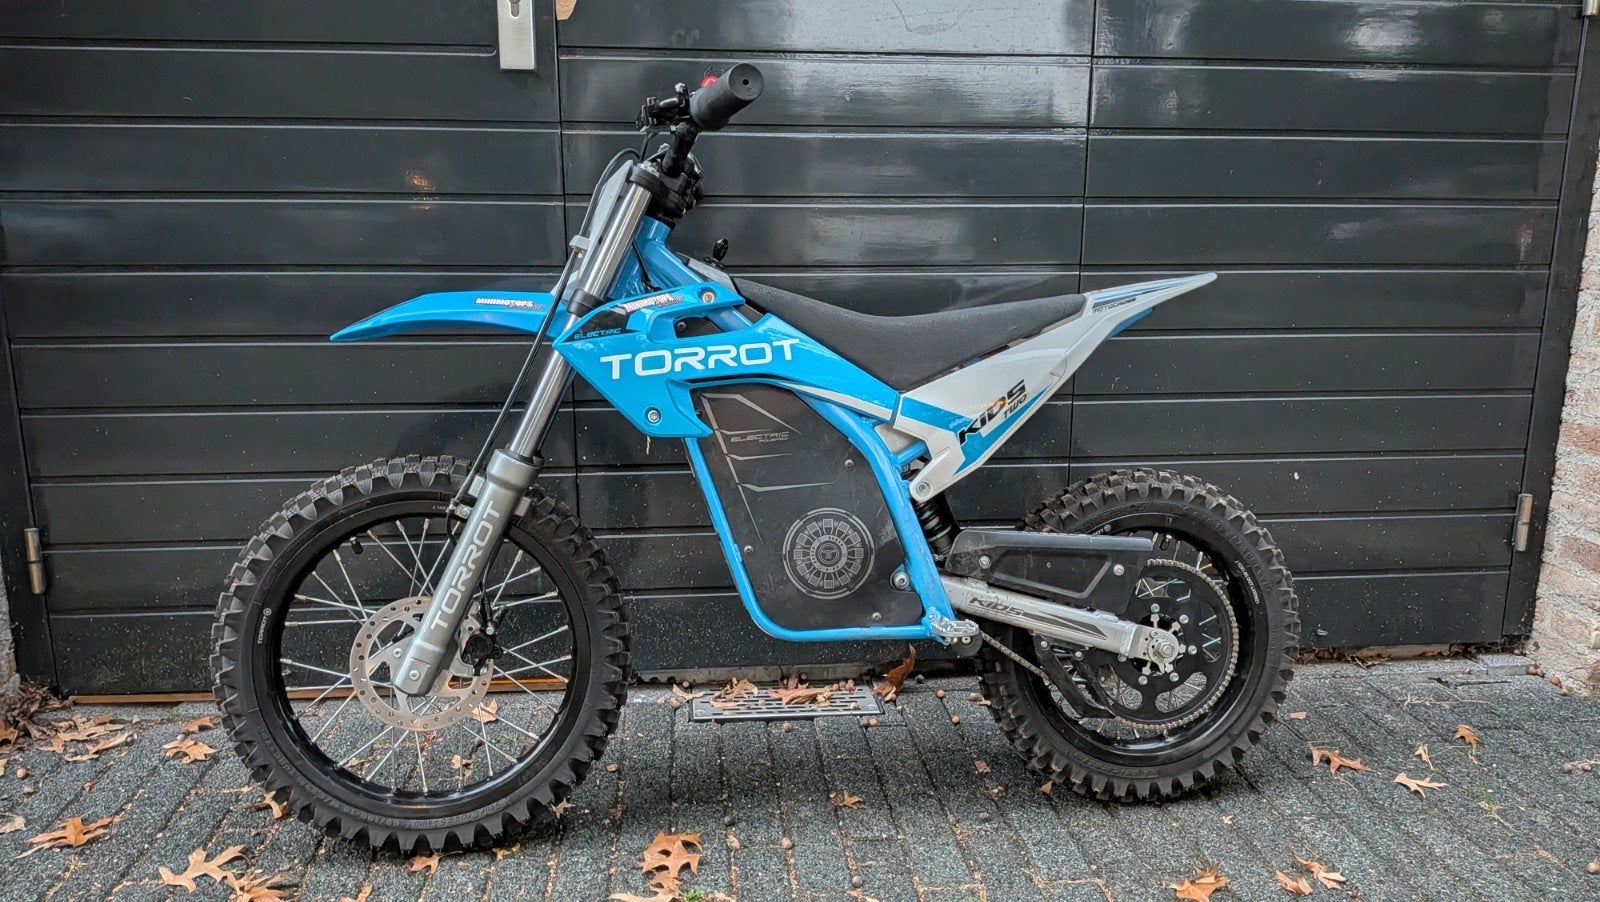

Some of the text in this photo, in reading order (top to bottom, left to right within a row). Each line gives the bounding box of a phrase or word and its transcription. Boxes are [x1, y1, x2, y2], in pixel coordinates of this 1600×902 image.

[573, 327, 622, 340] ELECTRIC
[599, 338, 800, 380] TORROT
[958, 379, 1027, 446] KIDS
[730, 431, 790, 443] ELECTRIC
[430, 499, 500, 630] TORROT
[968, 597, 1025, 617] KIDS
